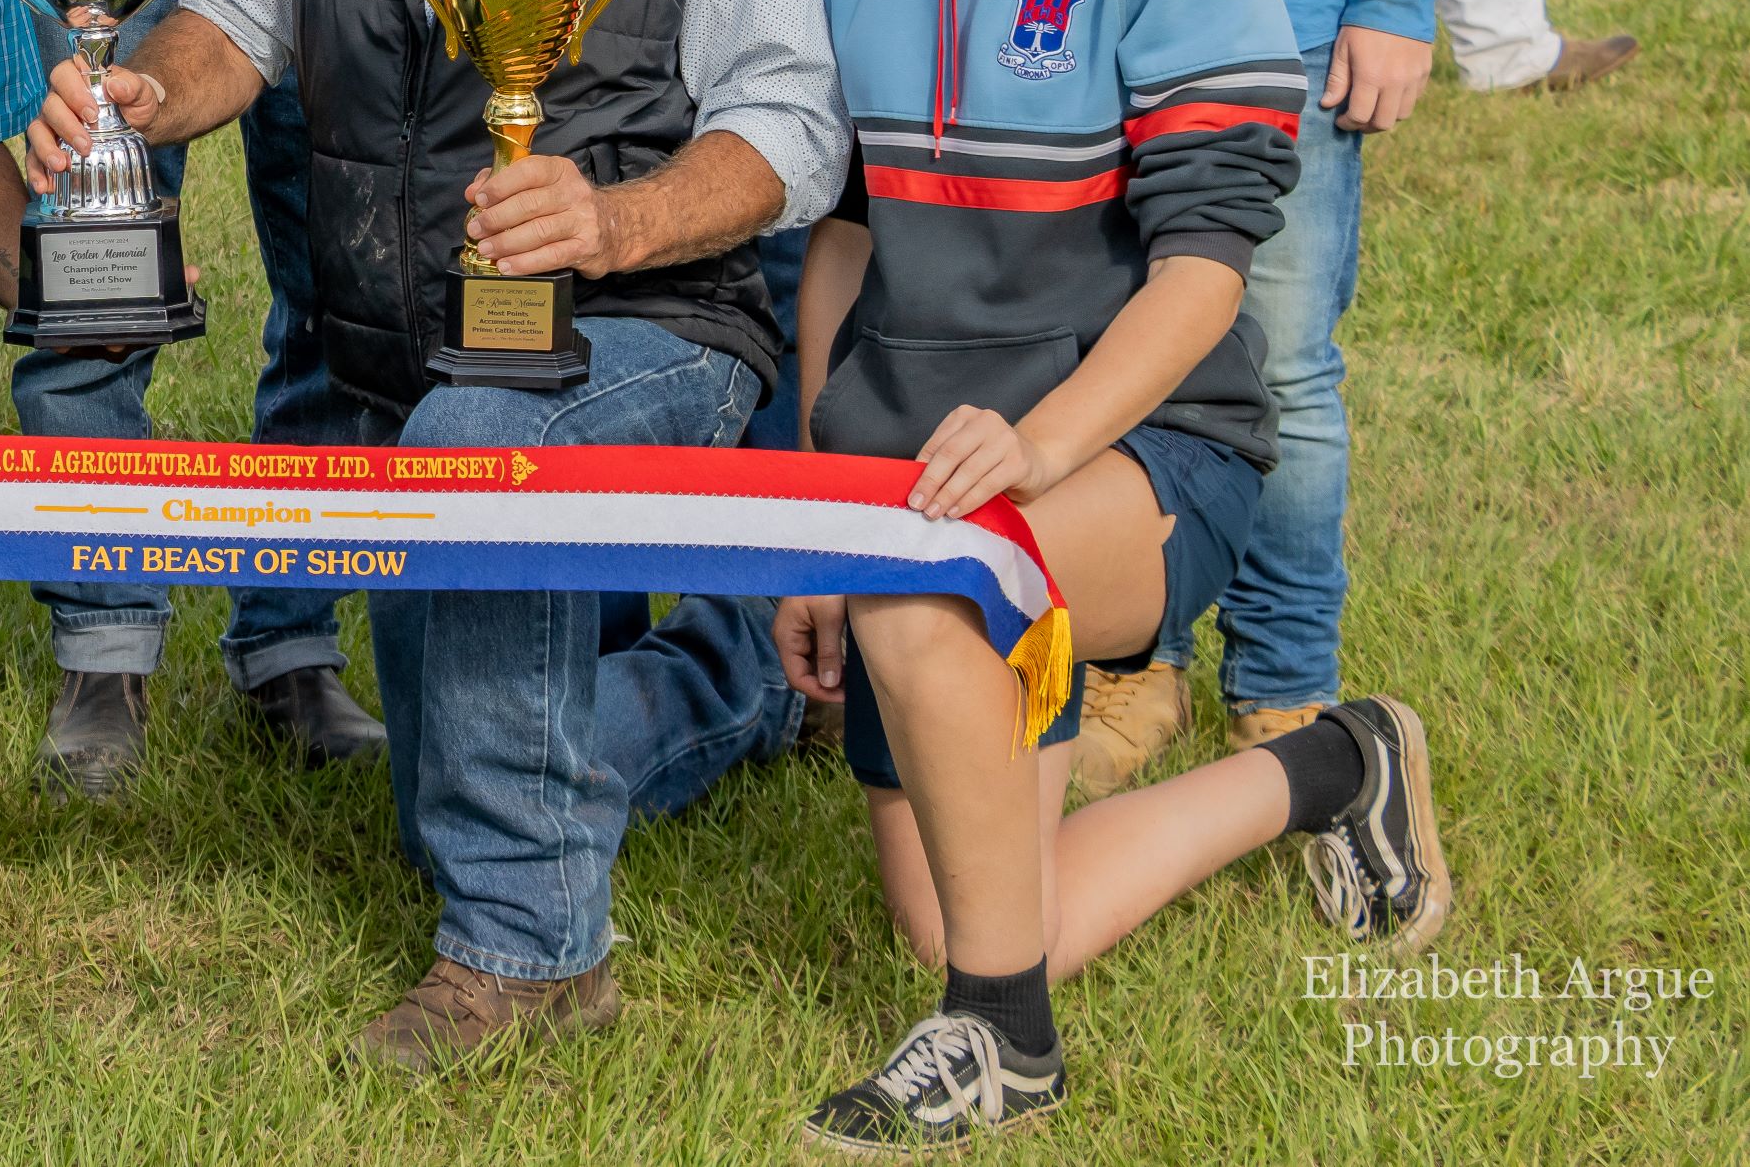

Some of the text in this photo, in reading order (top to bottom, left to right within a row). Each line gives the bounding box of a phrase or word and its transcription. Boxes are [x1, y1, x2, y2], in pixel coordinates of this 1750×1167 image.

[1016, 67, 1048, 79] CORONAT
[1050, 60, 1074, 70] OPUS
[51, 246, 147, 263] Leo Rosten Memorial
[63, 263, 138, 274] Champion Prime
[96, 276, 105, 284] of
[107, 275, 132, 283] Show
[50, 450, 221, 477] AGRICULTURAL
[229, 454, 318, 478] SOCIETY
[326, 456, 375, 478] LTD.
[386, 456, 506, 482] (KEMPSEY)
[162, 499, 312, 527] Champion
[72, 545, 407, 576] FAT BEAST OF SHOW
